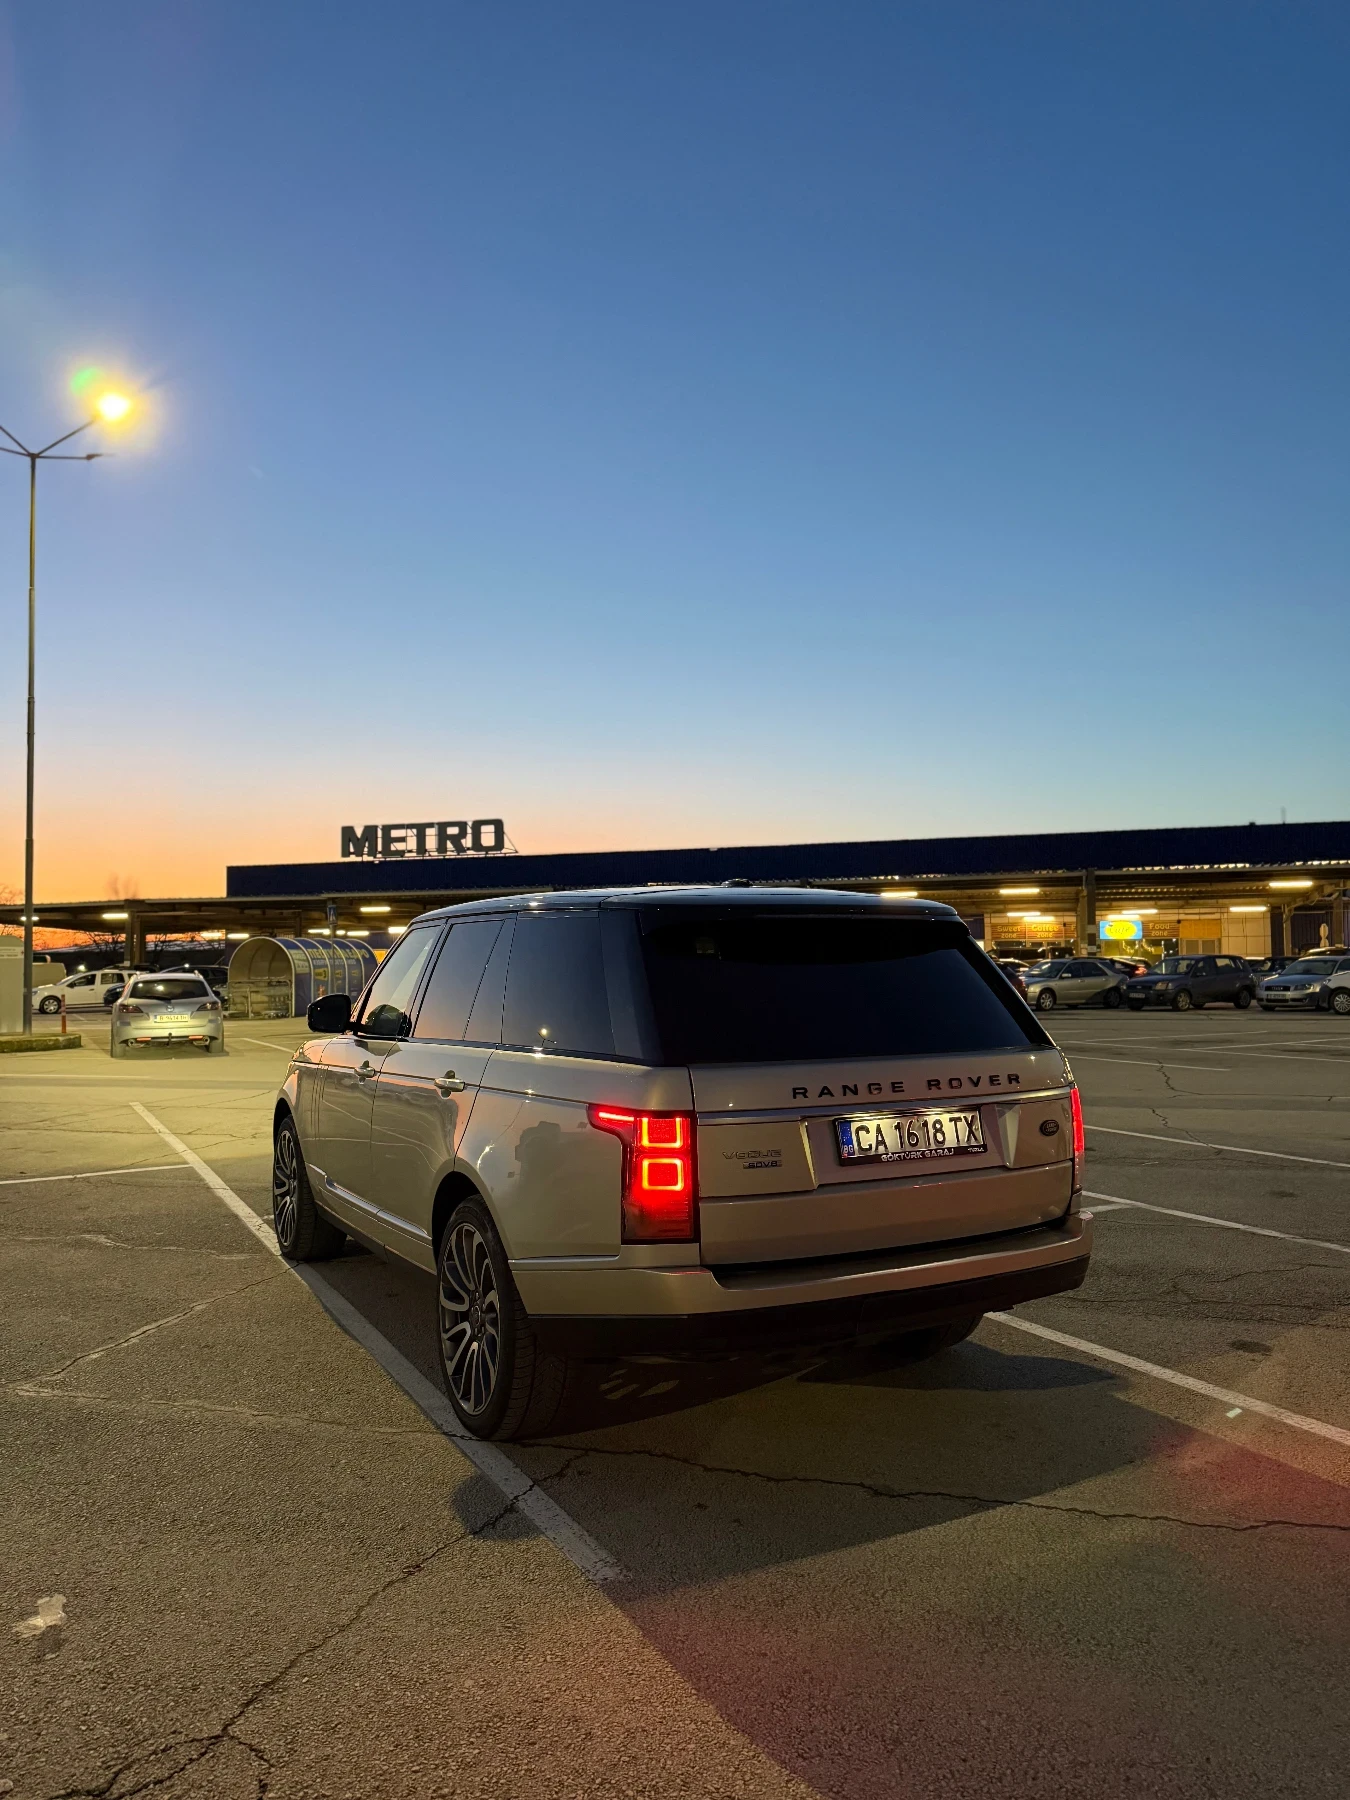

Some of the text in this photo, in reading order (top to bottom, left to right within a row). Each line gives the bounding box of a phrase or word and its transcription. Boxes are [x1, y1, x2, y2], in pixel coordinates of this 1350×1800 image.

[341, 818, 505, 858] METRO
[1031, 924, 1059, 932] Coffee
[1149, 922, 1170, 930] Food
[792, 1073, 1021, 1099] RANGE ROVER
[855, 1115, 979, 1153] CA 1618 TX
[843, 1144, 854, 1153] BG
[924, 1148, 954, 1158] GARAJ
[722, 1149, 782, 1159] VOGUE
[748, 1161, 778, 1169] SDV8
